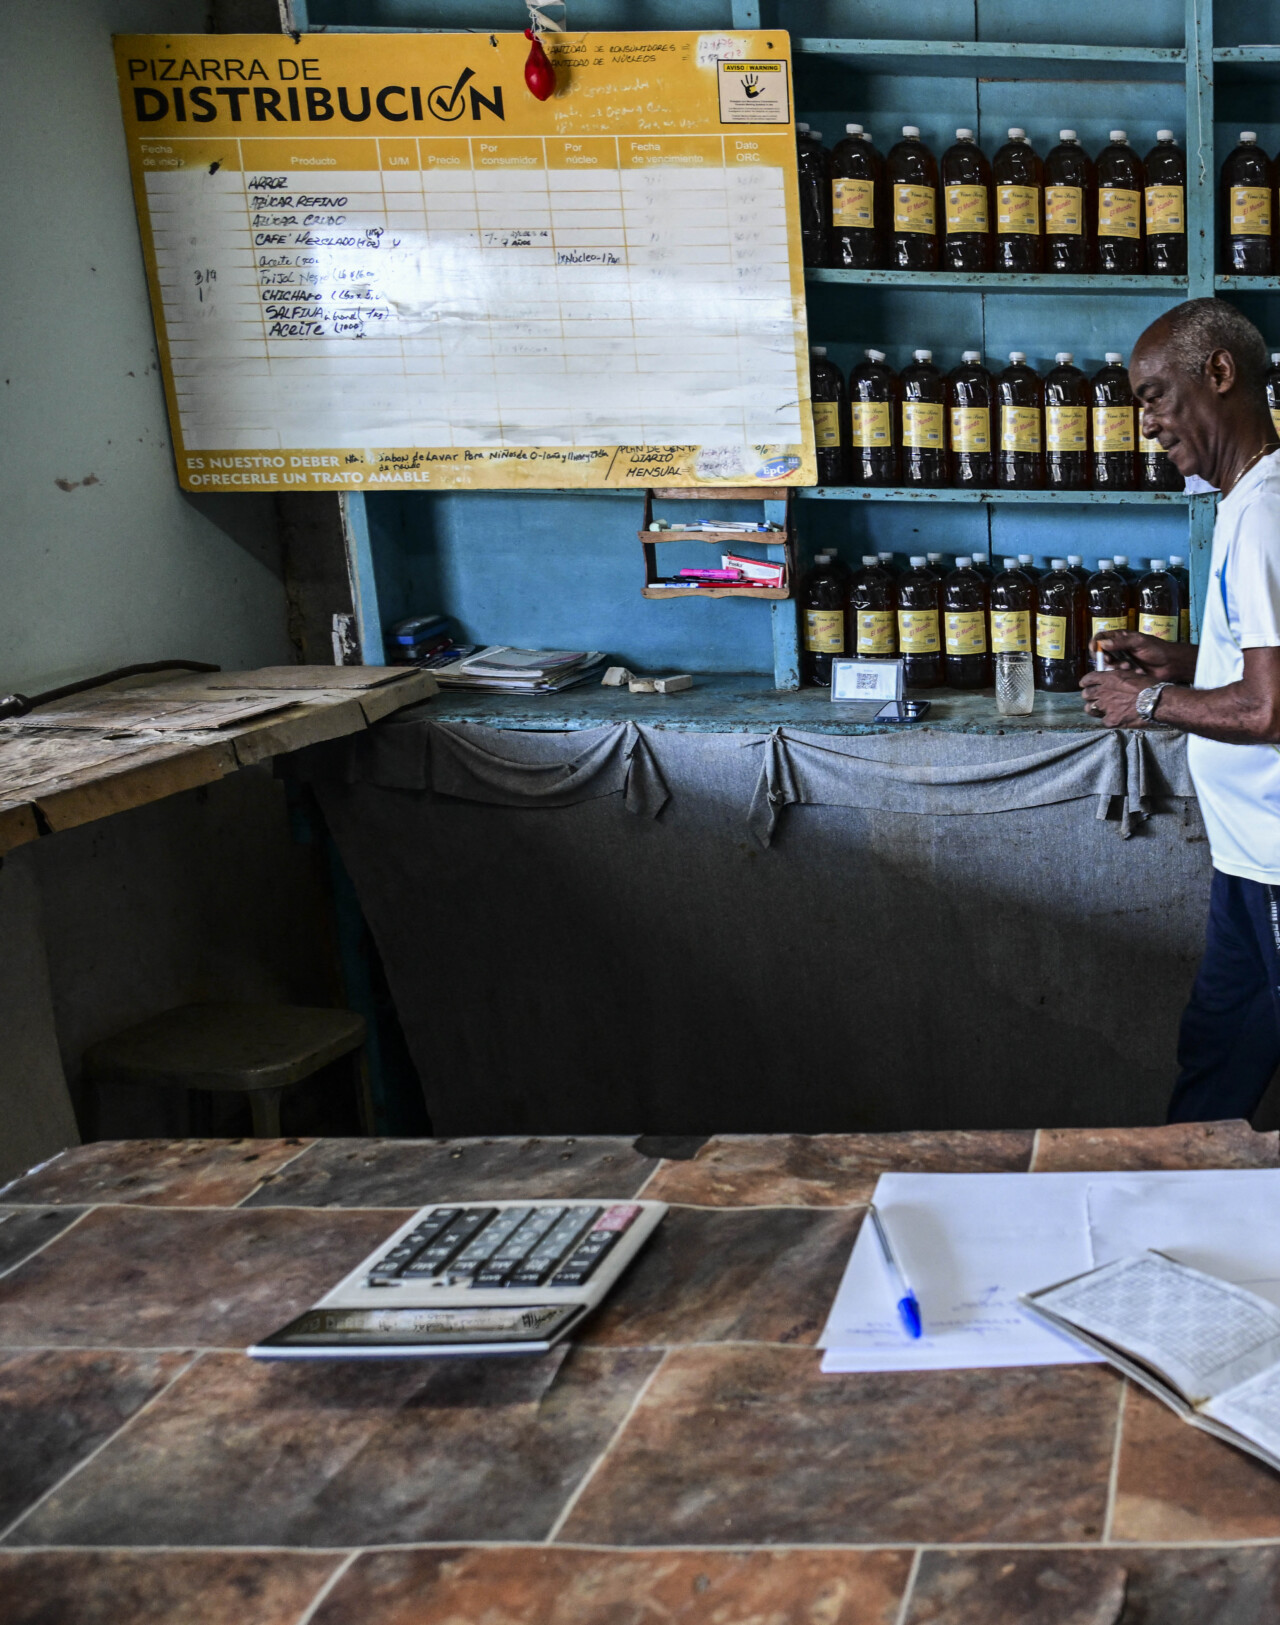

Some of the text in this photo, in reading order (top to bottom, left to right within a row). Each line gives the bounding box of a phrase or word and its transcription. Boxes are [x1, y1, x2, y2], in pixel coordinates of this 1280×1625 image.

[550, 59, 589, 67] ANTIDAD
[592, 57, 604, 66] DE
[128, 58, 322, 80] PIZARRA DE
[141, 145, 173, 154] Fecha
[480, 144, 498, 153] Por
[564, 143, 582, 152] Por
[631, 142, 661, 151] Fecha
[735, 141, 759, 150] Dato
[290, 156, 337, 166] Producto
[389, 157, 410, 165] U/M
[428, 155, 460, 165] Precio
[481, 156, 538, 165] consumidor
[565, 155, 598, 164] núcleo
[632, 154, 704, 164] de vencimiento
[736, 154, 761, 163] ORC
[248, 176, 288, 190] ARROZ
[296, 195, 348, 208] REFINO
[841, 200, 847, 208] El
[907, 205, 913, 213] El
[957, 206, 963, 214] El
[1008, 205, 1014, 214] El
[1109, 208, 1116, 217] El
[1243, 207, 1249, 215] El
[1104, 426, 1110, 435] El
[186, 456, 341, 469] ES NUESTRO DEBER
[630, 453, 675, 463] DIARIO
[763, 464, 785, 476] EpC
[188, 471, 431, 486] OFRECERLE UN TRATO AMABLE
[813, 628, 819, 636] El
[909, 628, 915, 637] El
[955, 630, 961, 639] El
